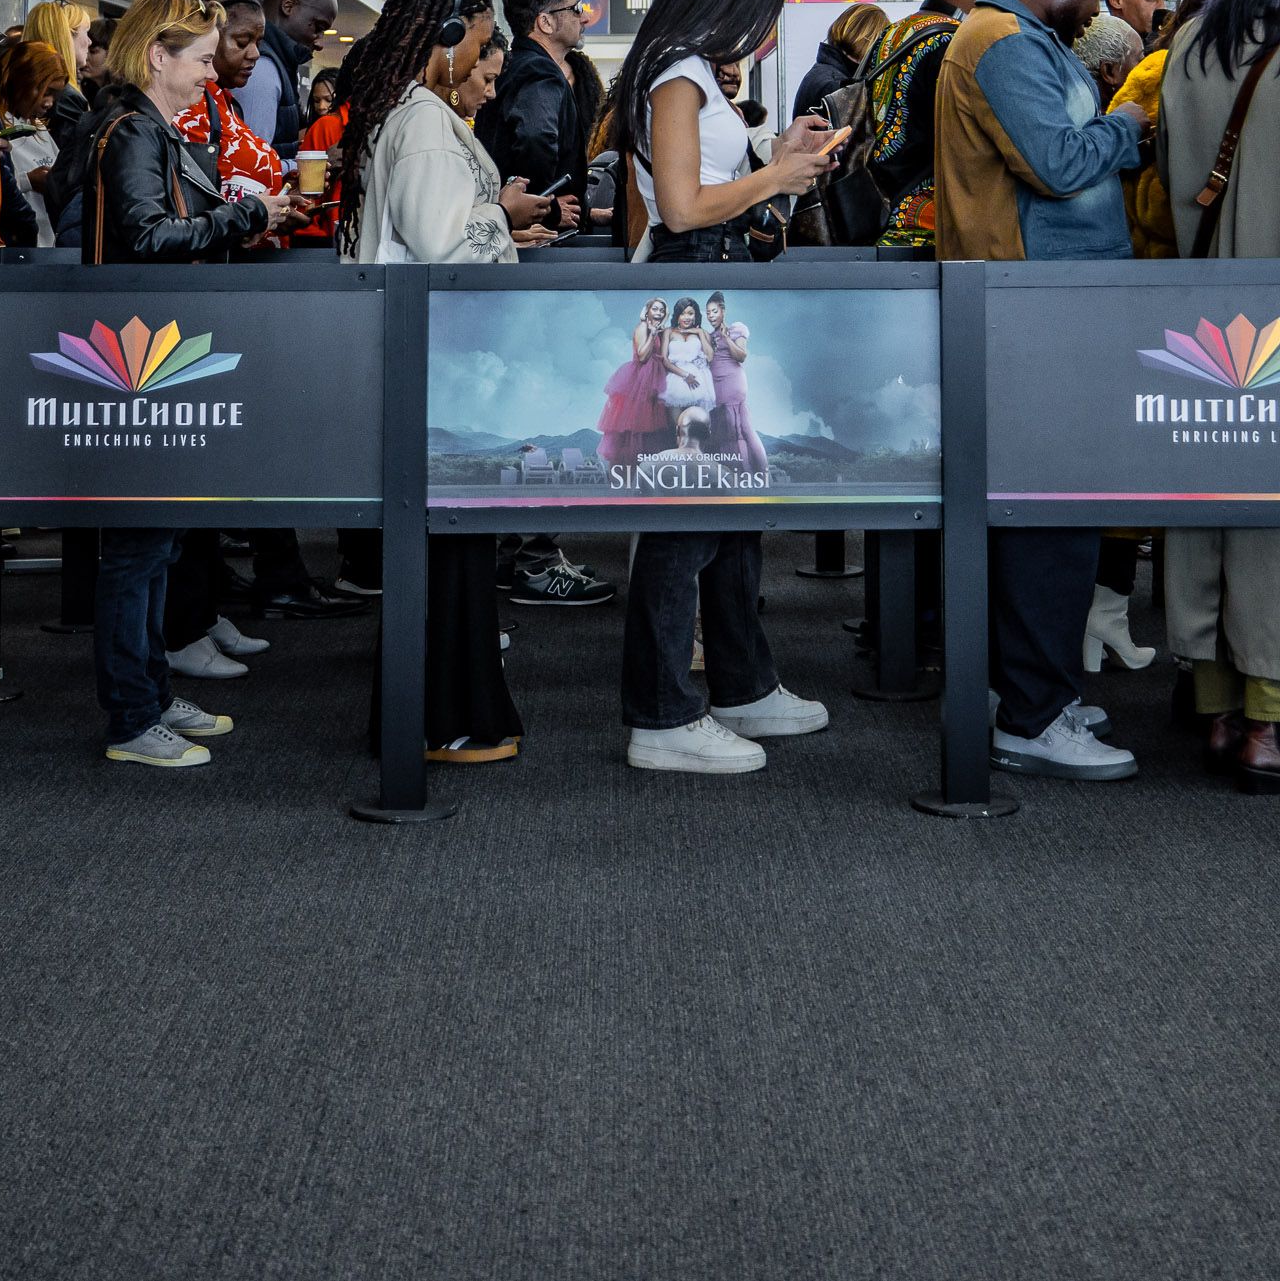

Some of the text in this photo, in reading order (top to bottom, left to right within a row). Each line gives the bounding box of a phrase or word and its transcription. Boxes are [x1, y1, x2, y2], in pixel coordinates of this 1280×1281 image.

[64, 434, 207, 447] ENRICHING LIVES
[1172, 430, 1261, 443] ENRICHING
[636, 452, 744, 462] SHOWMAX ORIGINAL
[610, 464, 770, 490] SINGLE kiasi
